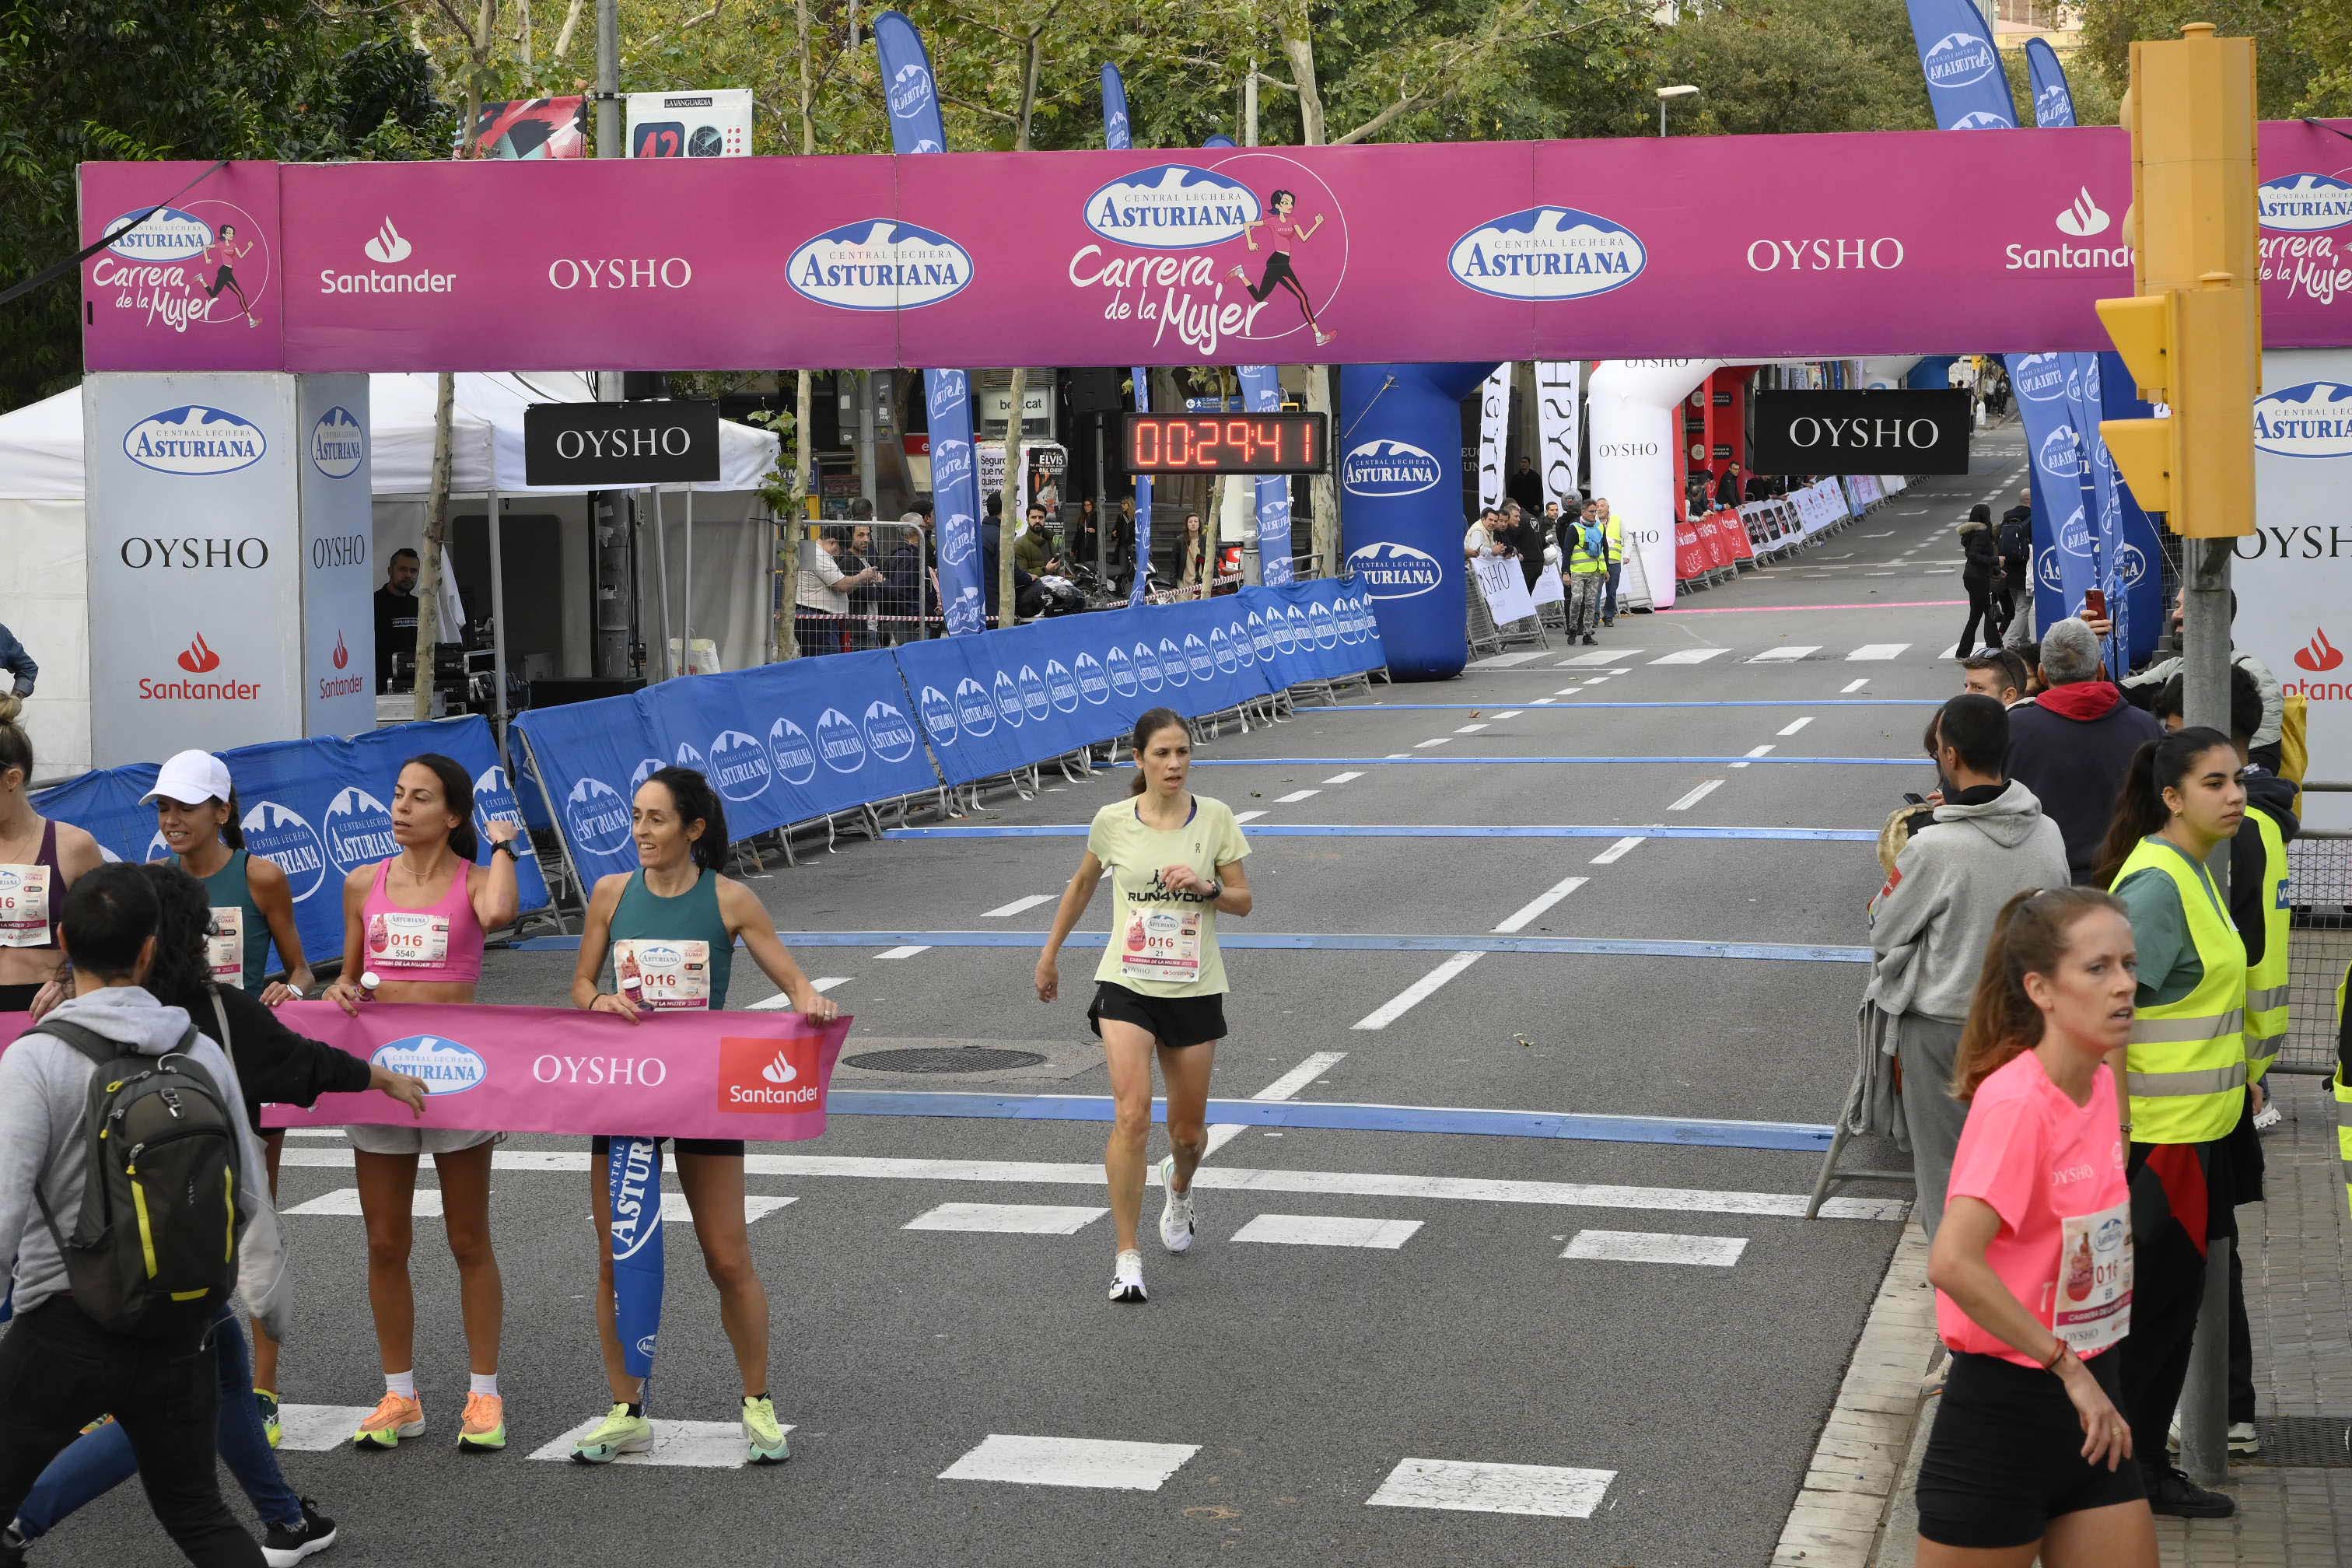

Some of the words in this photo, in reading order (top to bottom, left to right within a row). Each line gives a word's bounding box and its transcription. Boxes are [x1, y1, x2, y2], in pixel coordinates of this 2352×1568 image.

[1124, 193, 1180, 203] CENTRAL
[1186, 192, 1242, 201] LECHERA
[1097, 196, 1246, 228] ASTURIANA
[111, 226, 205, 248] ASTURIANA
[1493, 238, 1556, 249] CENTRAL
[1561, 237, 1626, 247] LECHERA
[2258, 236, 2333, 259] arrera
[829, 250, 887, 261] CENTRAL
[893, 249, 953, 259] LECHERA
[1069, 244, 1213, 289] Carrera
[1463, 241, 1632, 277] ASTURIANA
[1746, 237, 1905, 271] OYSHO
[2005, 243, 2136, 270] Santand
[93, 258, 184, 288] Carrera
[320, 269, 457, 293] Santander
[548, 257, 692, 289] OYSHO
[800, 253, 959, 287] ASTURIANA
[2277, 258, 2291, 281] la
[2287, 254, 2352, 305] Muje
[115, 287, 133, 309] de
[136, 287, 149, 309] la
[147, 285, 220, 333] Mujer
[1104, 290, 1131, 320] de
[1137, 289, 1157, 320] la
[1152, 283, 1269, 355] Mujer
[2274, 408, 2328, 416] CENTRAL
[135, 431, 257, 458] ASTURIANA
[315, 433, 361, 460] ASTURIANA
[556, 427, 691, 460] OYSHO
[1789, 417, 1939, 449] OYSHO
[1039, 454, 1063, 465] ELVIS
[1599, 442, 1658, 458] OYSHO
[1346, 463, 1434, 485] ASTURIANA
[120, 537, 269, 569] OYSHO
[313, 534, 366, 570] OYSHO
[2233, 525, 2352, 560] OYSH
[1349, 565, 1434, 585] TURIANA
[138, 677, 261, 701] Santander
[319, 673, 363, 700] Santander
[252, 835, 279, 849] CENTRAL
[280, 830, 310, 846] LECHERA
[339, 821, 366, 833] CENTRAL
[1128, 891, 1204, 902] RUN4YOU
[390, 933, 423, 947] 016
[1148, 936, 1174, 947] 016
[642, 954, 678, 963] ASTURIANA
[645, 974, 677, 986] 016
[533, 1054, 667, 1087] OYSHO
[730, 1085, 818, 1104] Santander
[611, 1140, 654, 1248] ASTUR
